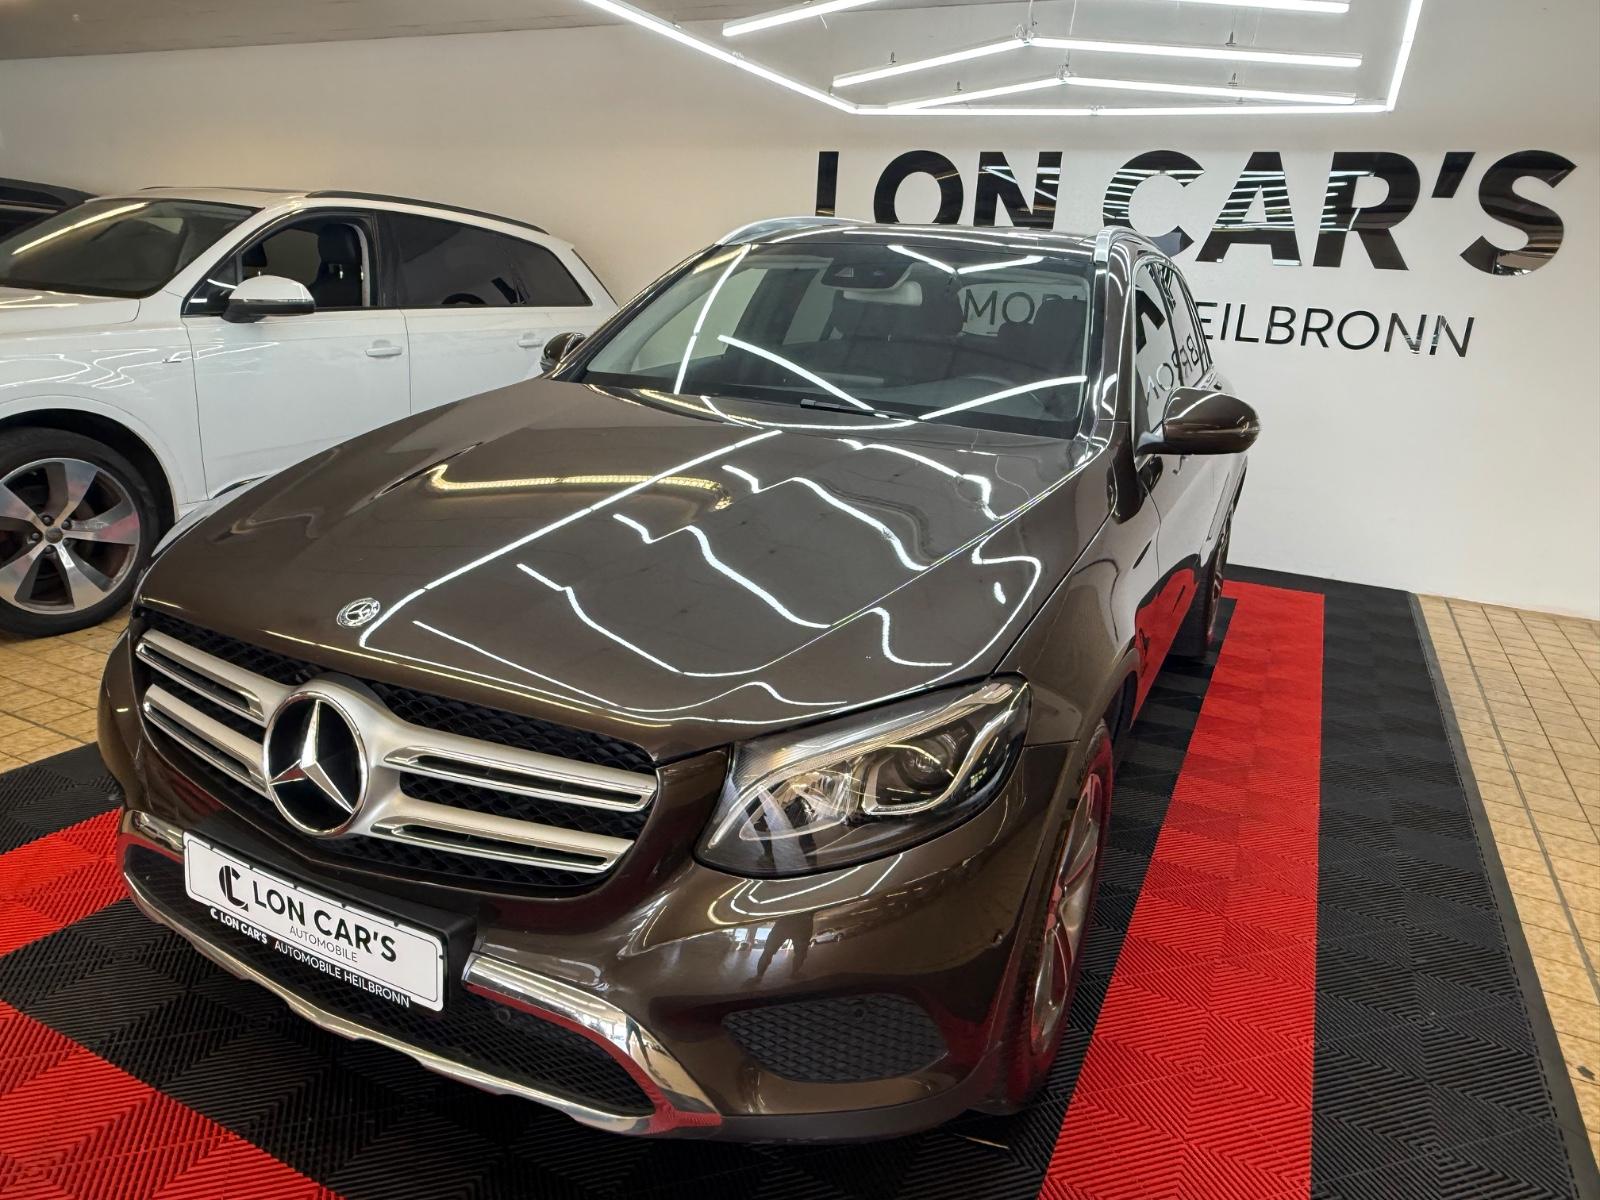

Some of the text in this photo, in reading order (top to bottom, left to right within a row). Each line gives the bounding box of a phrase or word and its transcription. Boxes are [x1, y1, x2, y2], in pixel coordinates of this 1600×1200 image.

[1102, 149, 1577, 276] CAR'S
[1195, 302, 1475, 357] EILBRONN
[220, 912, 240, 931] LON
[240, 923, 268, 945] CAR'S
[274, 940, 342, 979] AUTOMOBILE
[343, 971, 411, 1009] HEILBRONN
[252, 880, 398, 963] LON CAR'S
[289, 925, 358, 963] AUTOMOBILE
